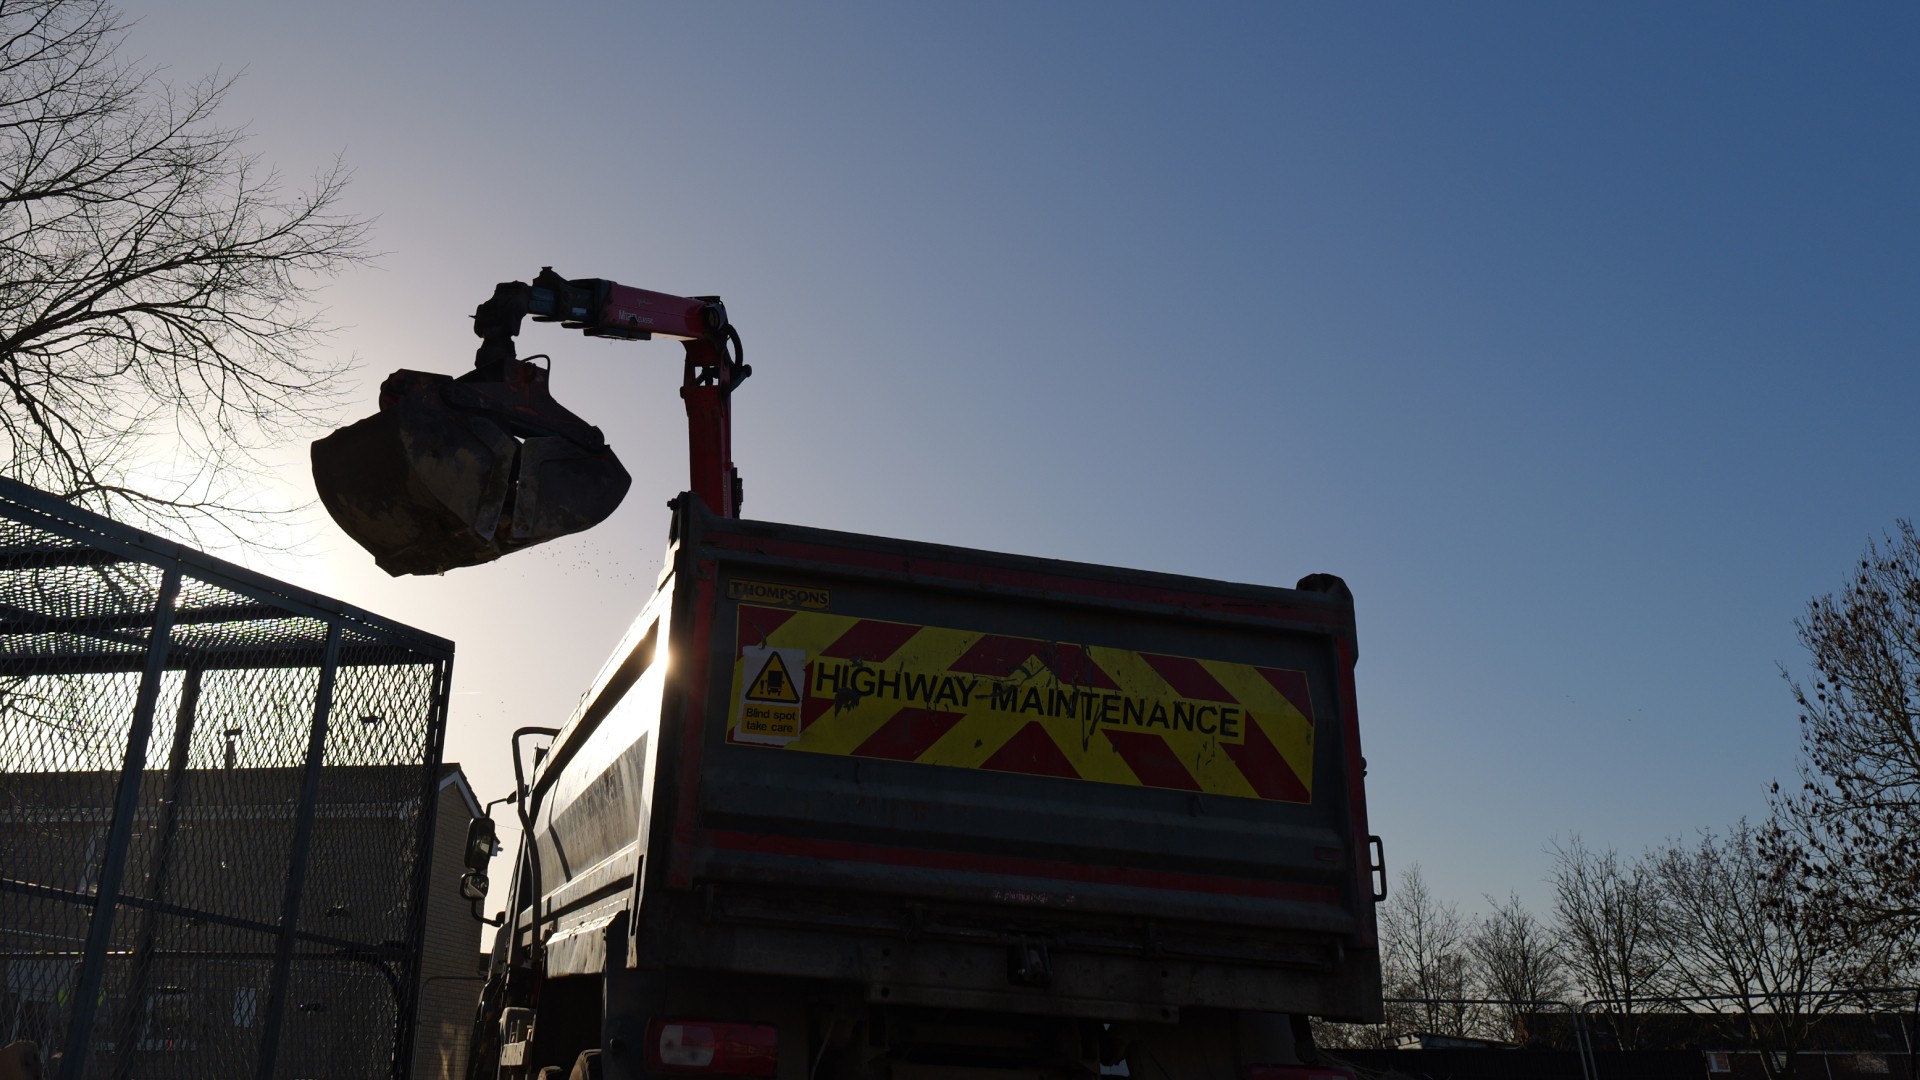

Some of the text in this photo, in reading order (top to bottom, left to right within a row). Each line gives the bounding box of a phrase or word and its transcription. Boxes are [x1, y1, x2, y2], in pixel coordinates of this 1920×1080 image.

[731, 581, 828, 604] THOMPSONS
[816, 662, 1240, 738] HIGHWAY MAINTENANCE
[746, 708, 796, 722] Blind spot
[746, 720, 793, 733] take care
